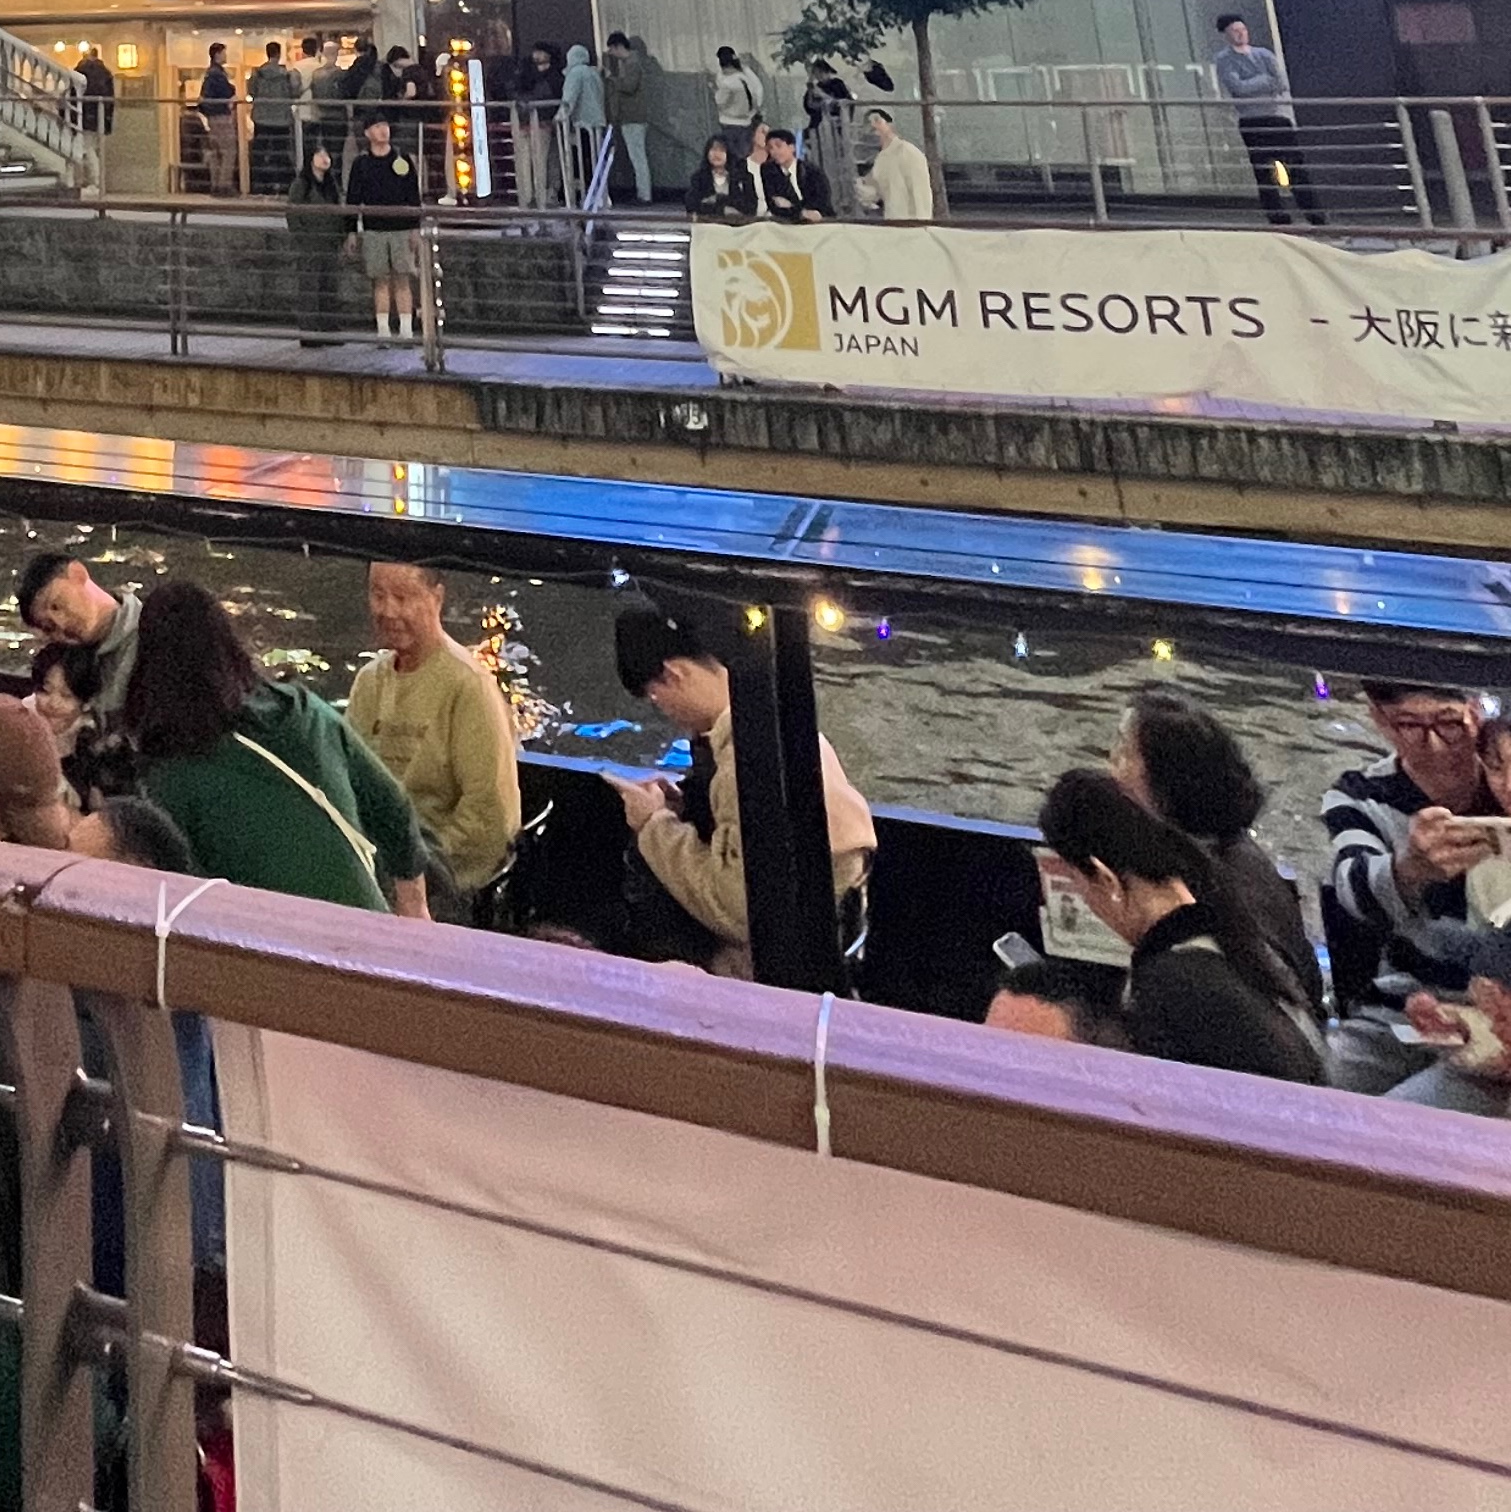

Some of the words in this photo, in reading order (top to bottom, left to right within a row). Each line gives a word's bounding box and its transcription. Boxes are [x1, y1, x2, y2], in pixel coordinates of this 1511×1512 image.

[828, 284, 958, 328] MGM
[979, 290, 1266, 339] RESORTS
[833, 332, 920, 357] JAPAN
